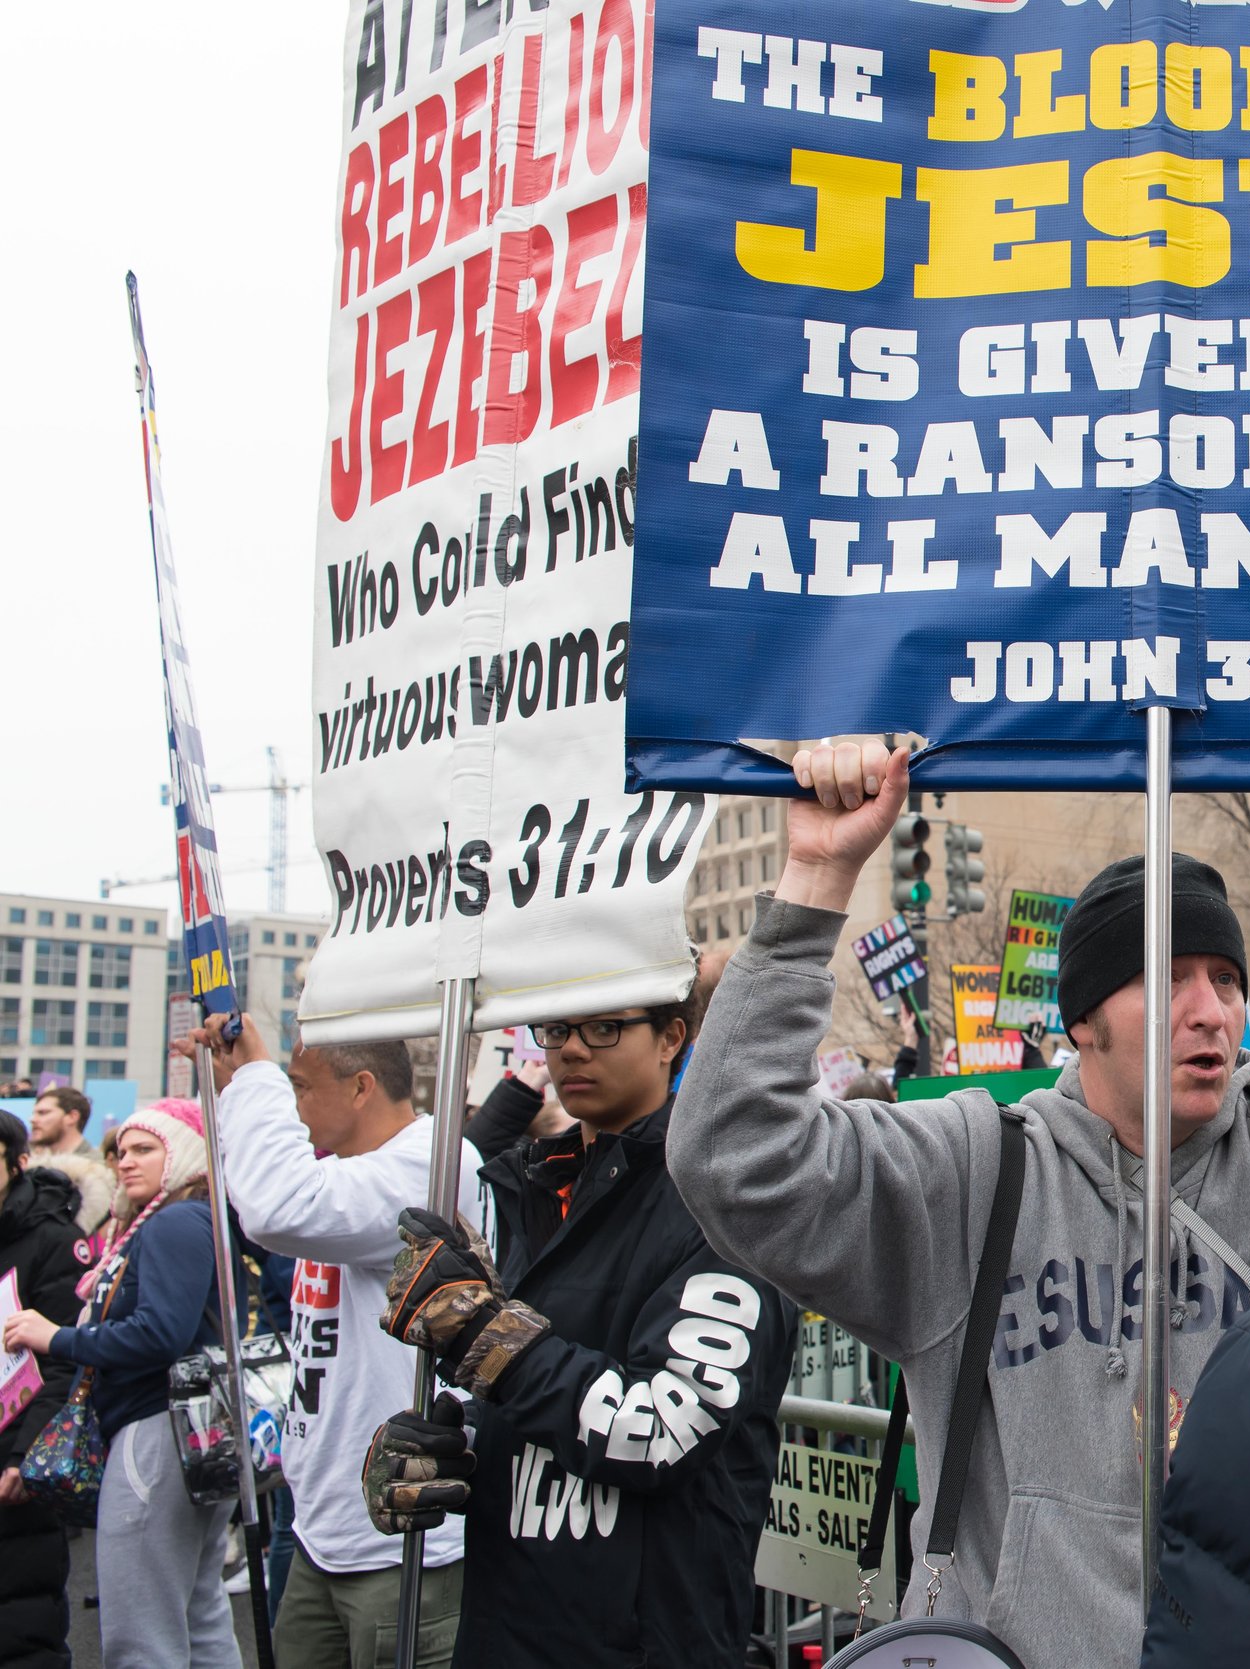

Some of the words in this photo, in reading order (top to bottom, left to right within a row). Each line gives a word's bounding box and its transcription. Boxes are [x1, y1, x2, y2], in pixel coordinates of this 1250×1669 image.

[697, 26, 883, 122] THE
[331, 183, 647, 523] JEZEBEL
[803, 319, 919, 402] IS
[688, 408, 780, 491] A
[709, 511, 959, 597] ALL
[327, 550, 398, 648] Who
[950, 635, 1180, 703] JOHN
[508, 790, 706, 909] 31:10
[852, 914, 907, 958] CIVIL
[863, 935, 916, 979] RIGHTS
[889, 960, 926, 992] ALL
[665, 1272, 761, 1409] GOD
